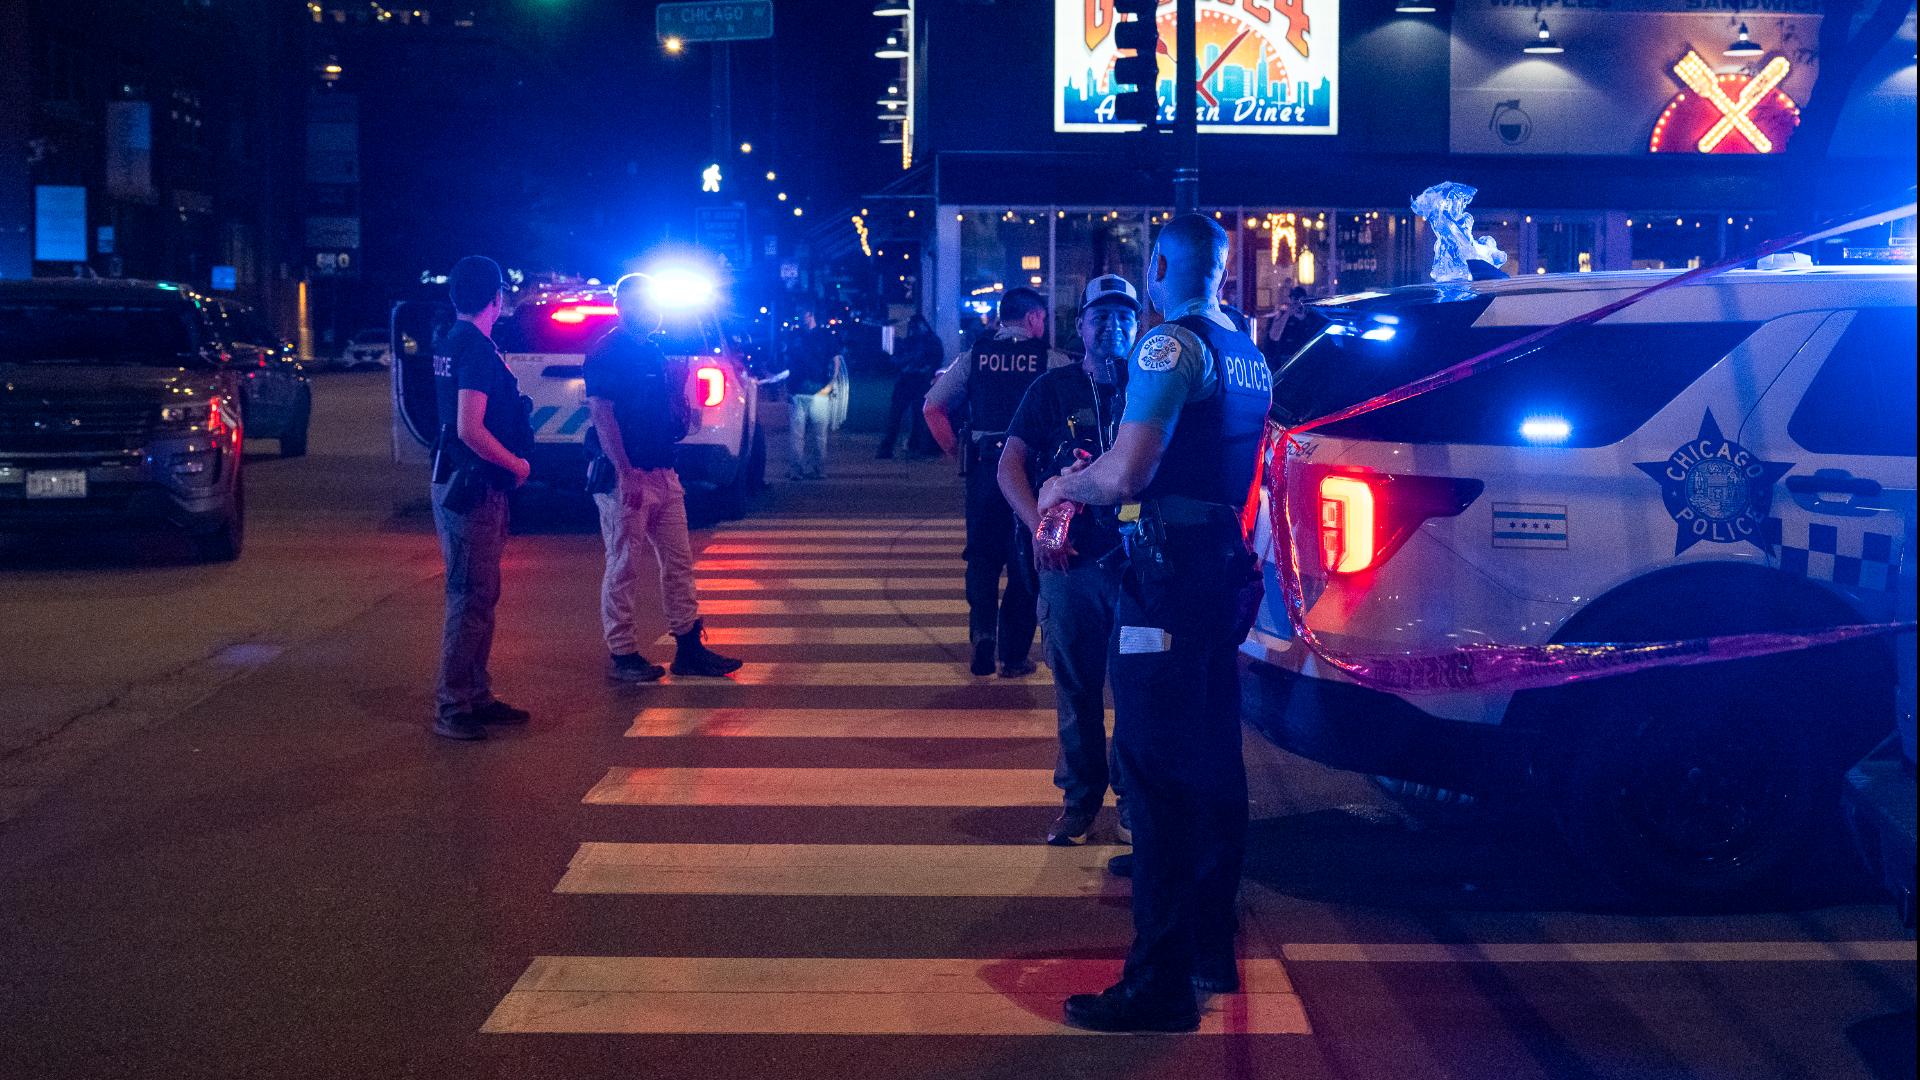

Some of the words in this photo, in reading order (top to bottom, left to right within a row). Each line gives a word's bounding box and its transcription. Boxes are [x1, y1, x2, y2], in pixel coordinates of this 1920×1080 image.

[681, 6, 744, 23] CHICAGO
[1234, 96, 1306, 122] Diner
[1144, 337, 1177, 353] CHICAGO
[979, 354, 1038, 372] POLICE
[1142, 356, 1171, 369] POLICE
[1225, 356, 1269, 392] POLICE
[1666, 440, 1764, 482] CHICAGO
[1675, 506, 1764, 540] POLICE
